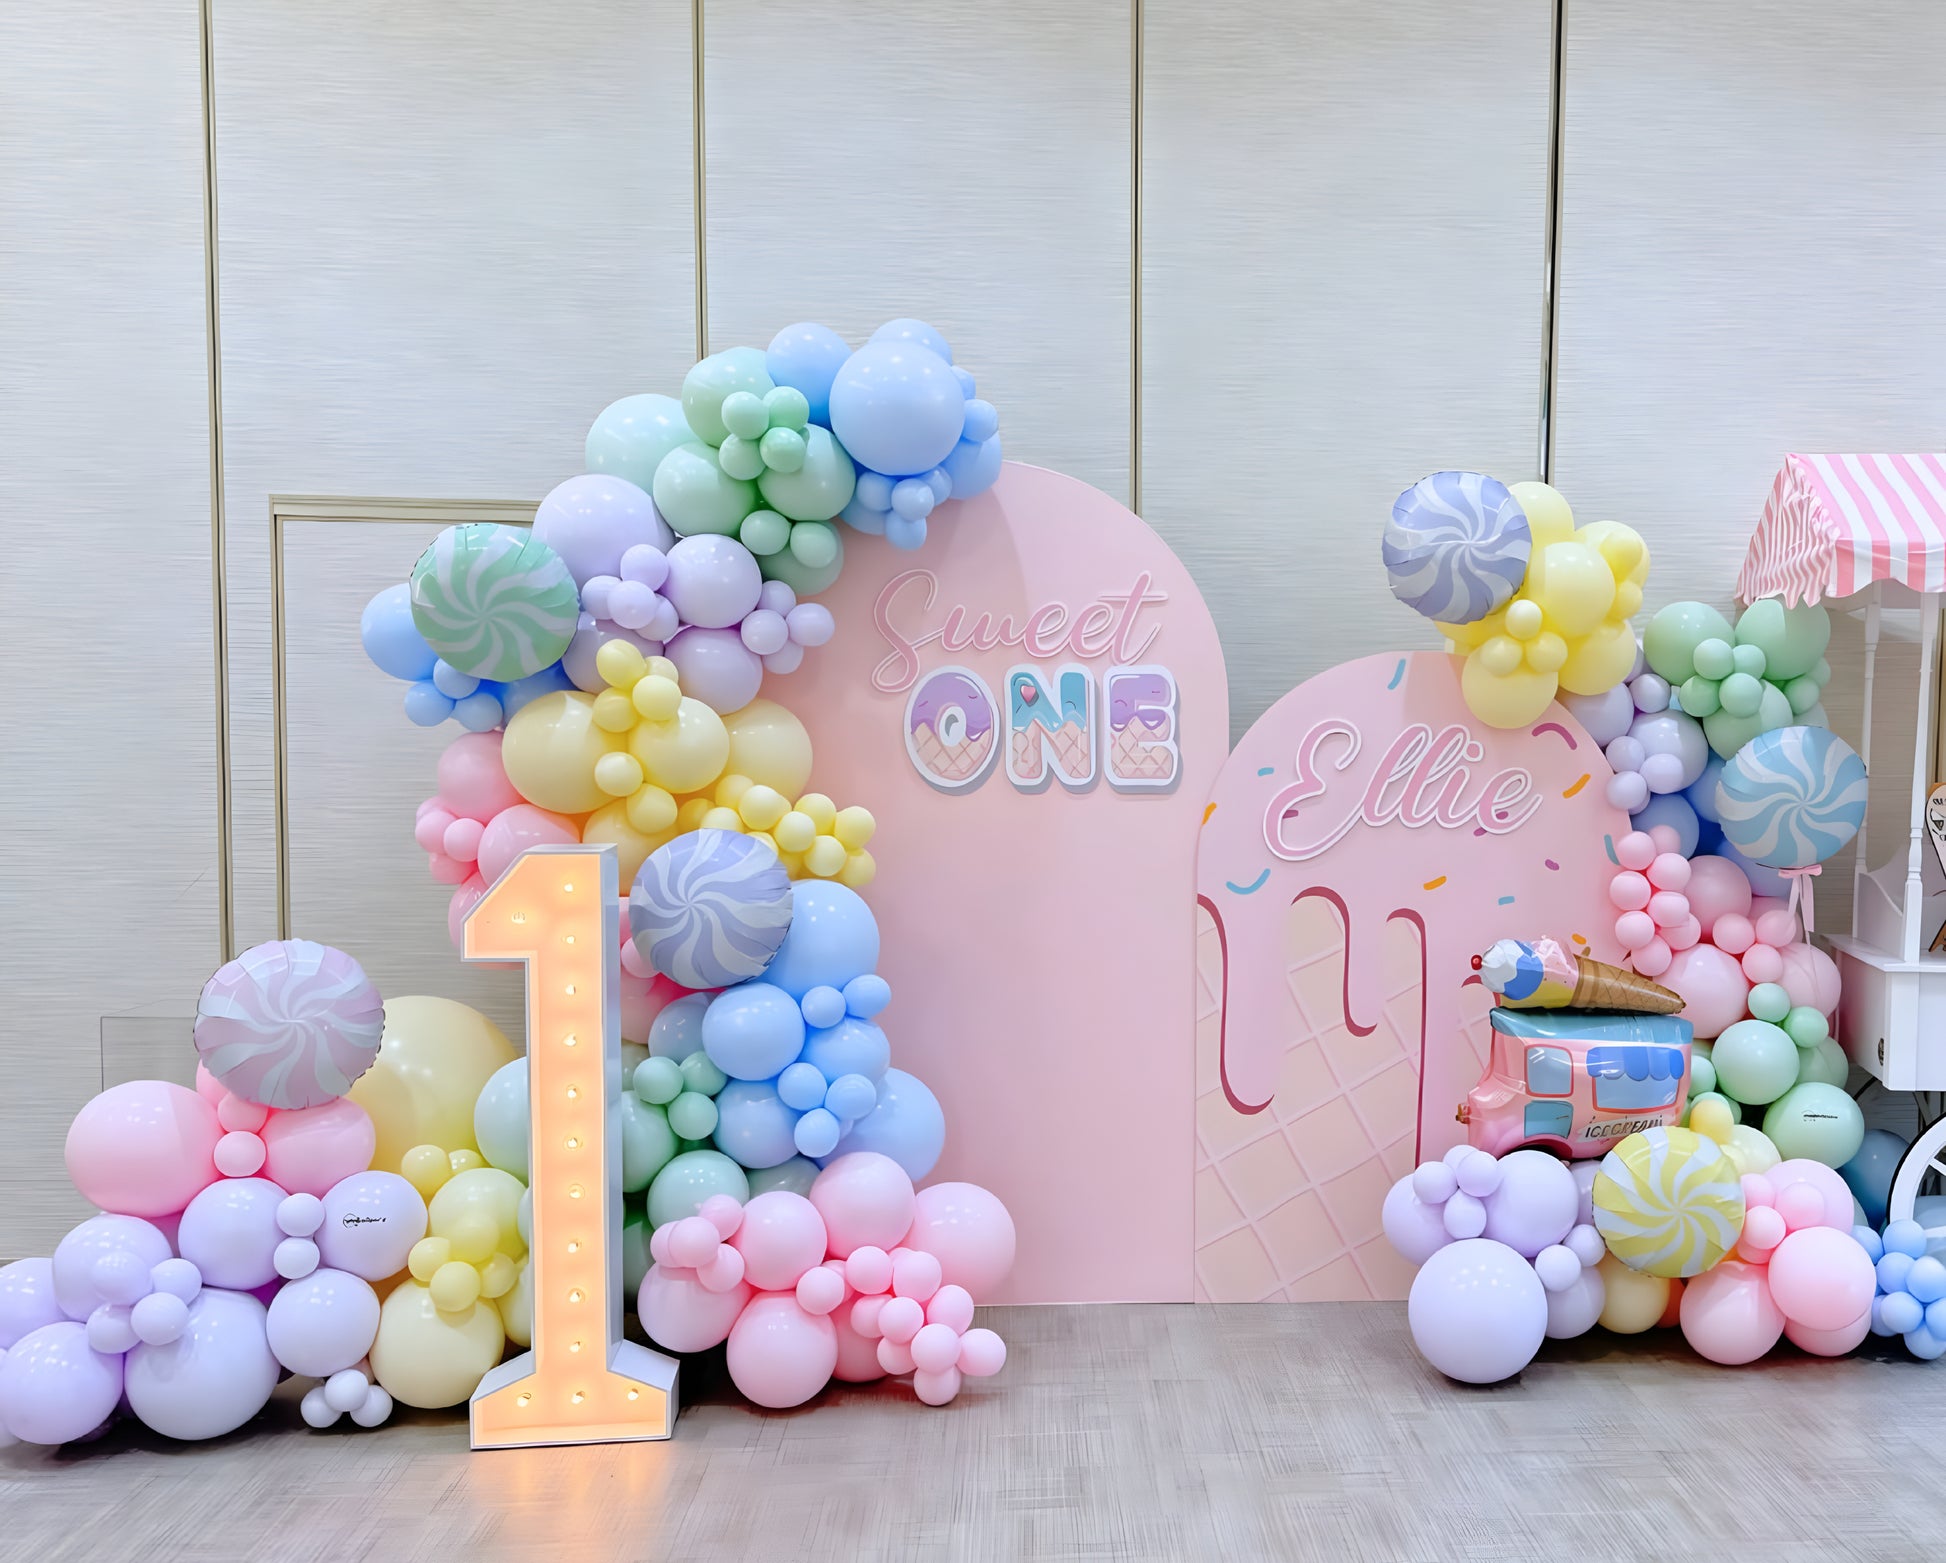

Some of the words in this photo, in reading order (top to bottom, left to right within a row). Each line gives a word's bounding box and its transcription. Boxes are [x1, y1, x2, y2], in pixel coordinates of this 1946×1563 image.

[872, 569, 1169, 693] Sweet
[904, 663, 1177, 787] ONE
[1263, 718, 1543, 861] Ellie
[462, 844, 680, 1450] 1
